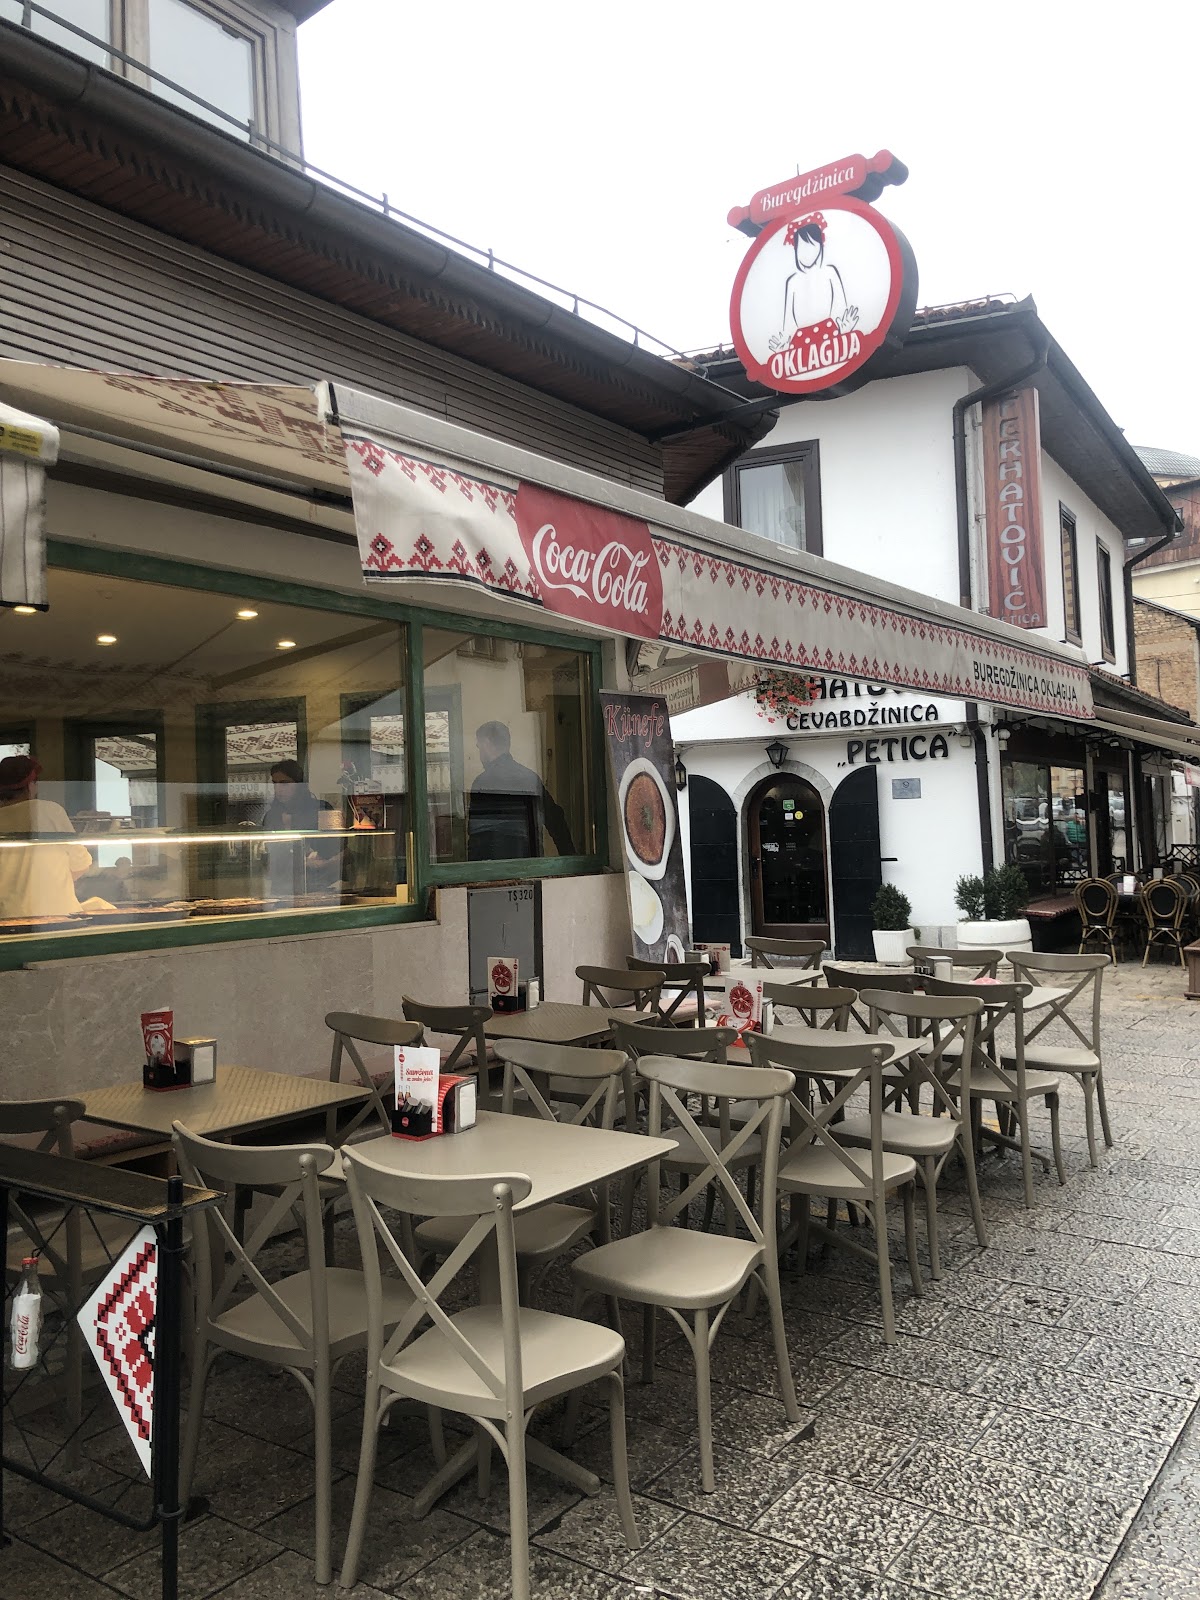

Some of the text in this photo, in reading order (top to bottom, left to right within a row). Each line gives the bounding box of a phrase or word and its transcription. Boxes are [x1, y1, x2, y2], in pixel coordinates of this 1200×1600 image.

[760, 165, 855, 212] Buregdžinica
[771, 332, 861, 380] OKLAGIJA
[532, 524, 649, 615] Coca-Cola
[997, 612, 1041, 628] ETICA
[973, 660, 1078, 702] BUREGDŽINICA OKLAGIJA
[604, 702, 665, 748] Künefe
